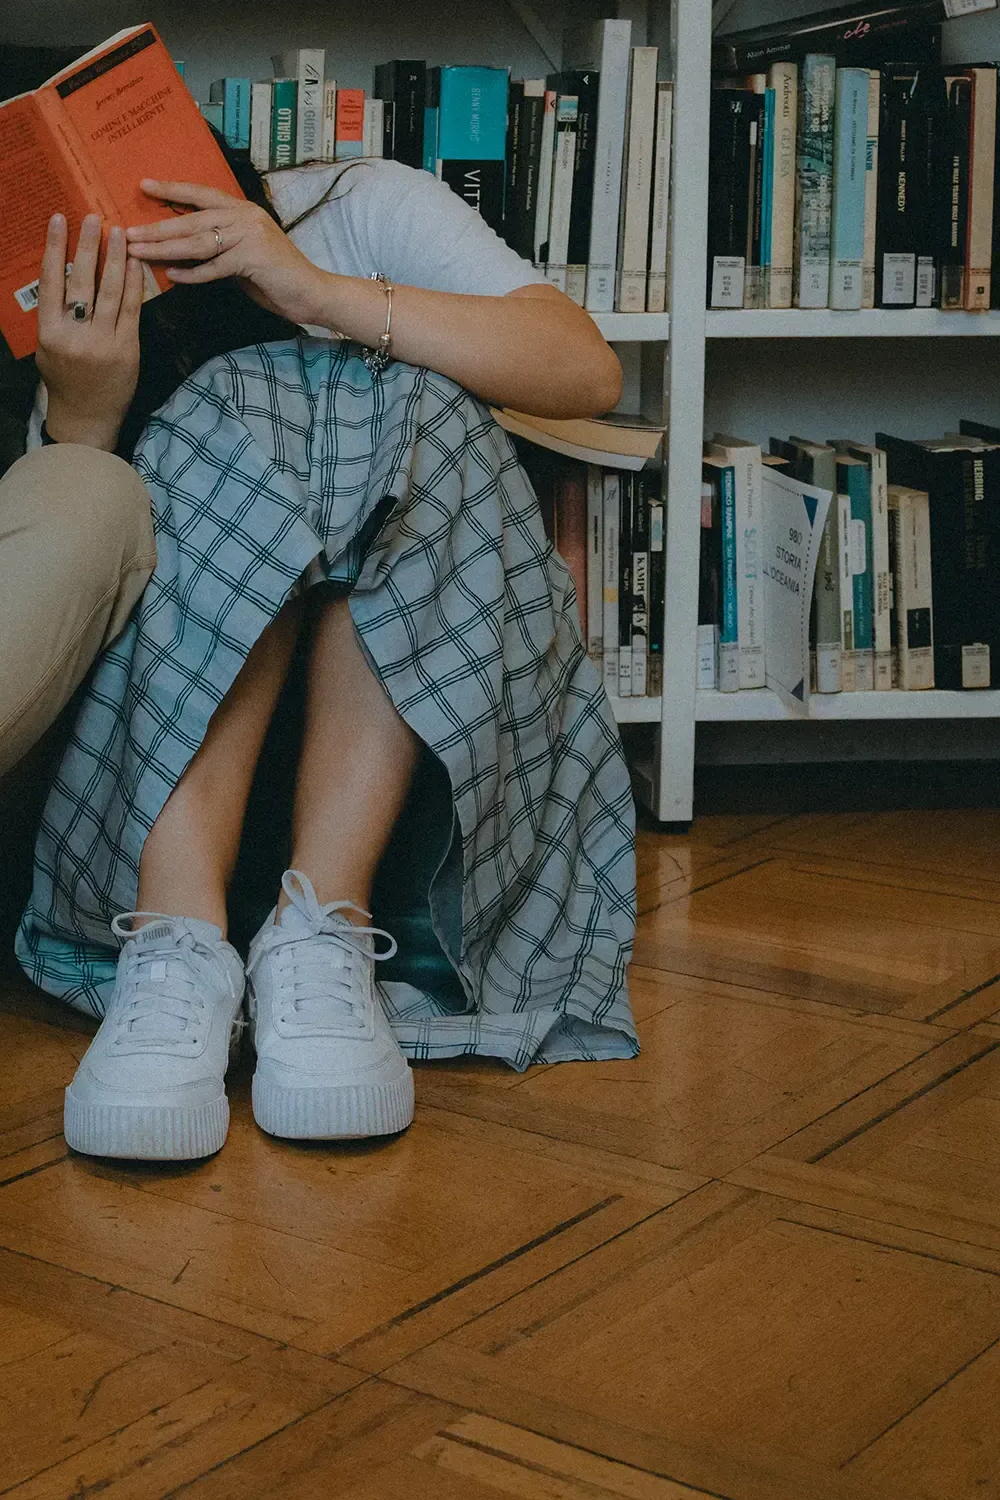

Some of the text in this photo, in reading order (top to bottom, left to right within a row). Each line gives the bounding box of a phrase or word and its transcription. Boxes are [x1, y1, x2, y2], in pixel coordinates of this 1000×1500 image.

[90, 117, 122, 141] UOMINI
[127, 86, 173, 117] MACCHINE
[469, 87, 481, 143] BENNY MORRIS
[782, 73, 792, 118] Andreotti
[107, 103, 166, 144] INTELLIGENTI
[275, 107, 292, 164] NTO GIALLO
[303, 108, 316, 154] GUERRA
[463, 169, 482, 212] VITT
[897, 171, 907, 213] KENNEDY
[973, 459, 984, 501] HERRING
[746, 487, 755, 519] Preston
[788, 527, 803, 546] 980
[775, 545, 803, 571] STORIA
